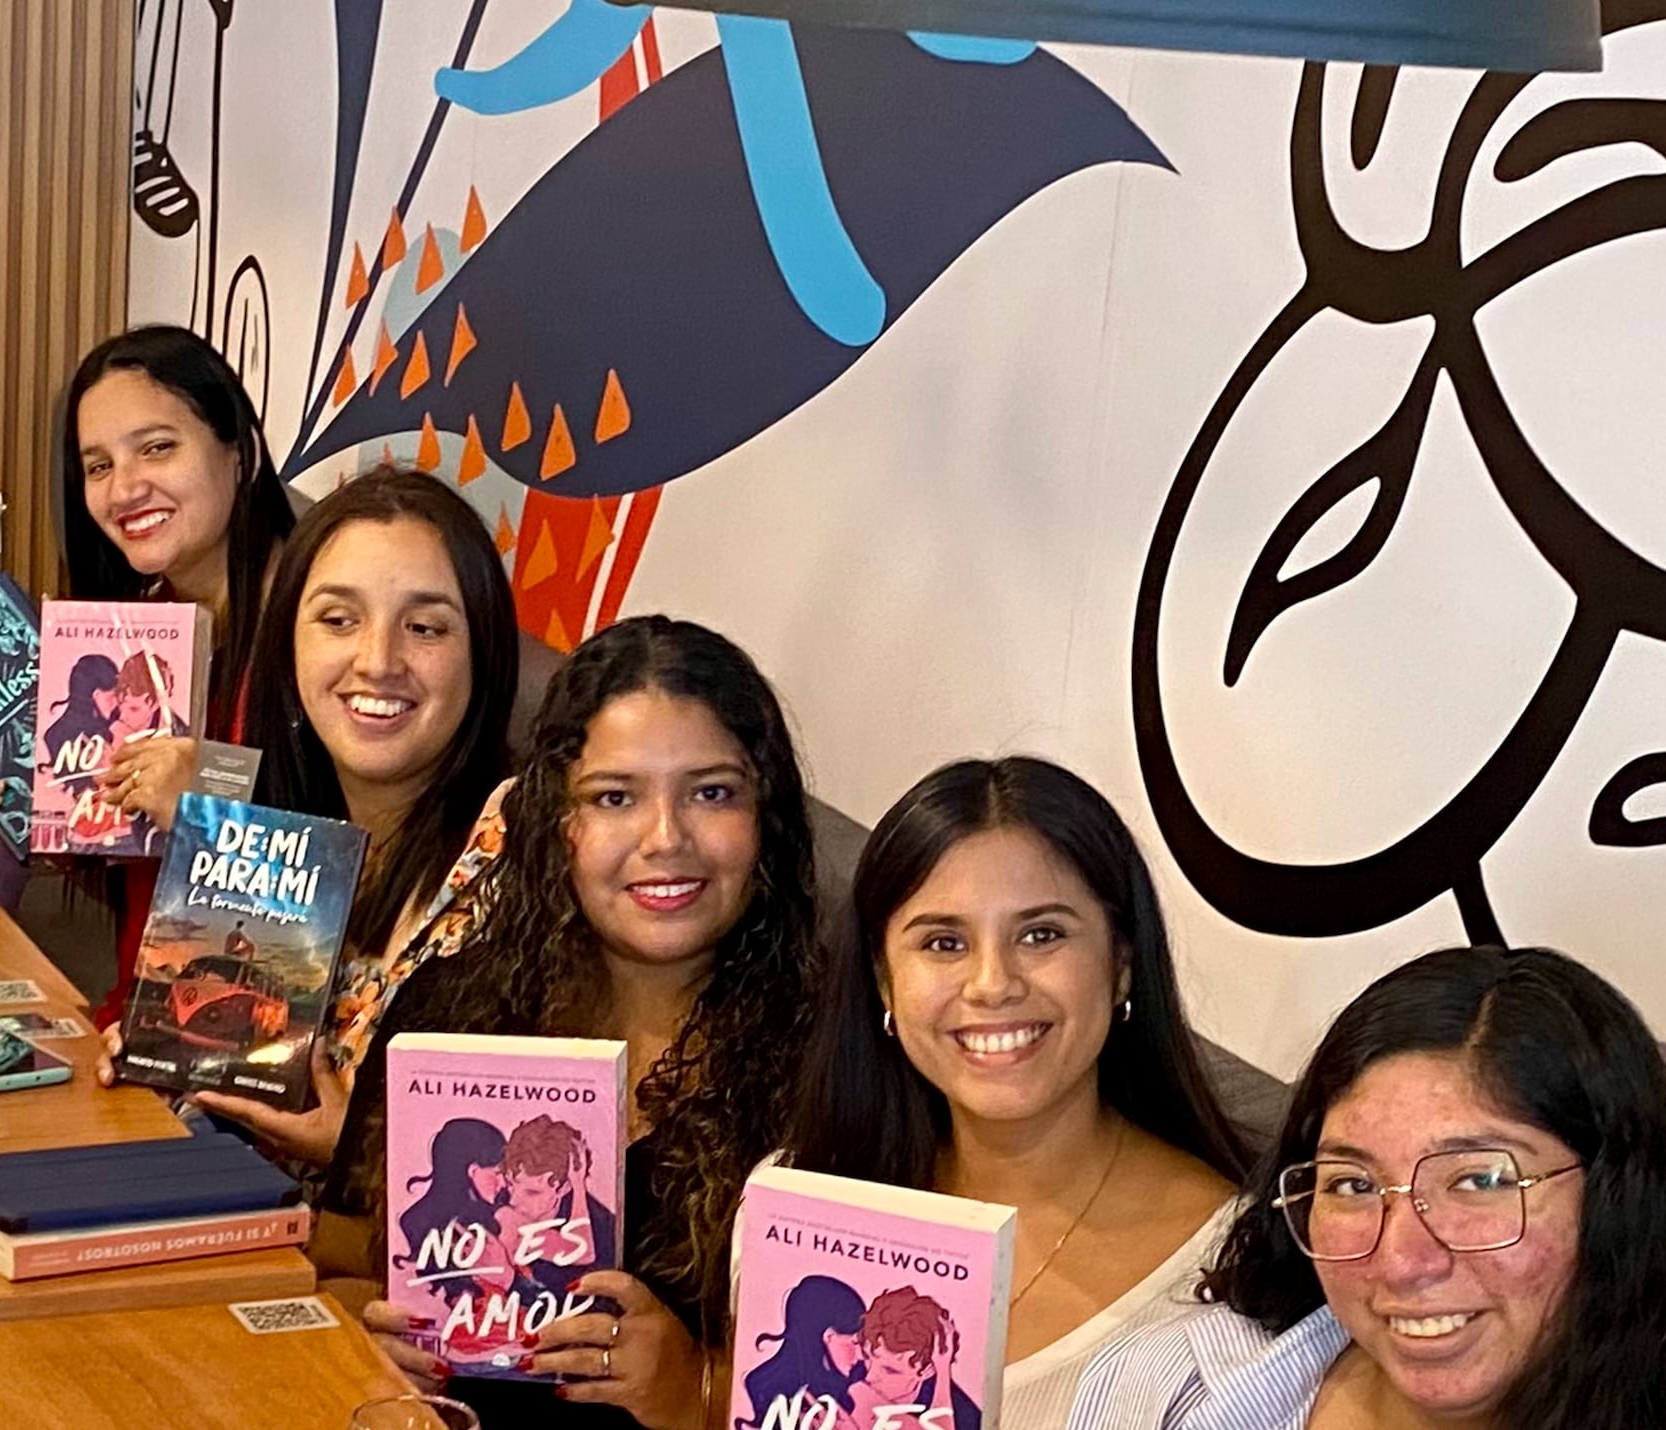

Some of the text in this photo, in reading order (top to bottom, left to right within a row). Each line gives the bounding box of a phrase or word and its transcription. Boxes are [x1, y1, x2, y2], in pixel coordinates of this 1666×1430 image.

[54, 626, 180, 641] ALI HAZELWOOD
[54, 733, 104, 775] NO
[408, 1079, 597, 1104] ALI HAZELWOOD
[246, 1227, 260, 1240] SI
[416, 1216, 591, 1271] NO ES
[765, 1224, 802, 1248] ALI
[813, 1230, 971, 1282] HAZELWOOD
